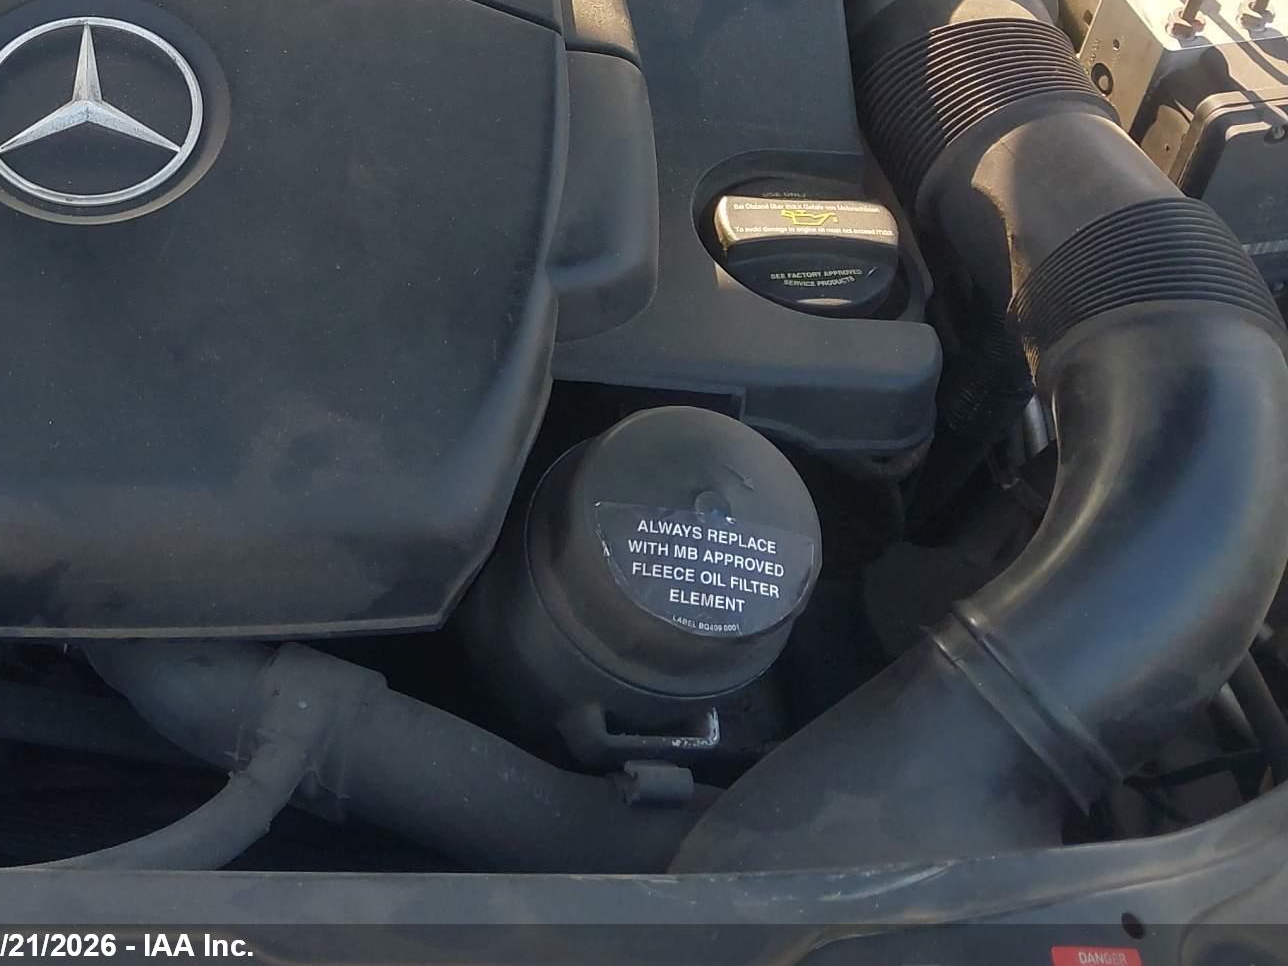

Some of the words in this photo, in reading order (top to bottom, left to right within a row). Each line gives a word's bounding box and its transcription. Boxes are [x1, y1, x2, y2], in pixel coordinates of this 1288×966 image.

[762, 226, 787, 234] damage
[783, 278, 816, 287] SERVICE
[816, 275, 856, 287] PRODUCTS
[787, 271, 821, 280] FACTORY
[823, 268, 862, 278] APPROVED
[637, 519, 702, 540] ALWAYS
[707, 528, 777, 554] REPLACE
[628, 539, 669, 556] WITH
[674, 545, 699, 561] MB
[703, 550, 785, 578] APPROVED
[632, 561, 695, 583] FLEECE
[700, 571, 726, 587] OIL
[730, 576, 780, 599] FILTER
[669, 589, 746, 613] ELEMENT
[672, 614, 697, 628] LABEL
[1078, 951, 1127, 965] DANGER
